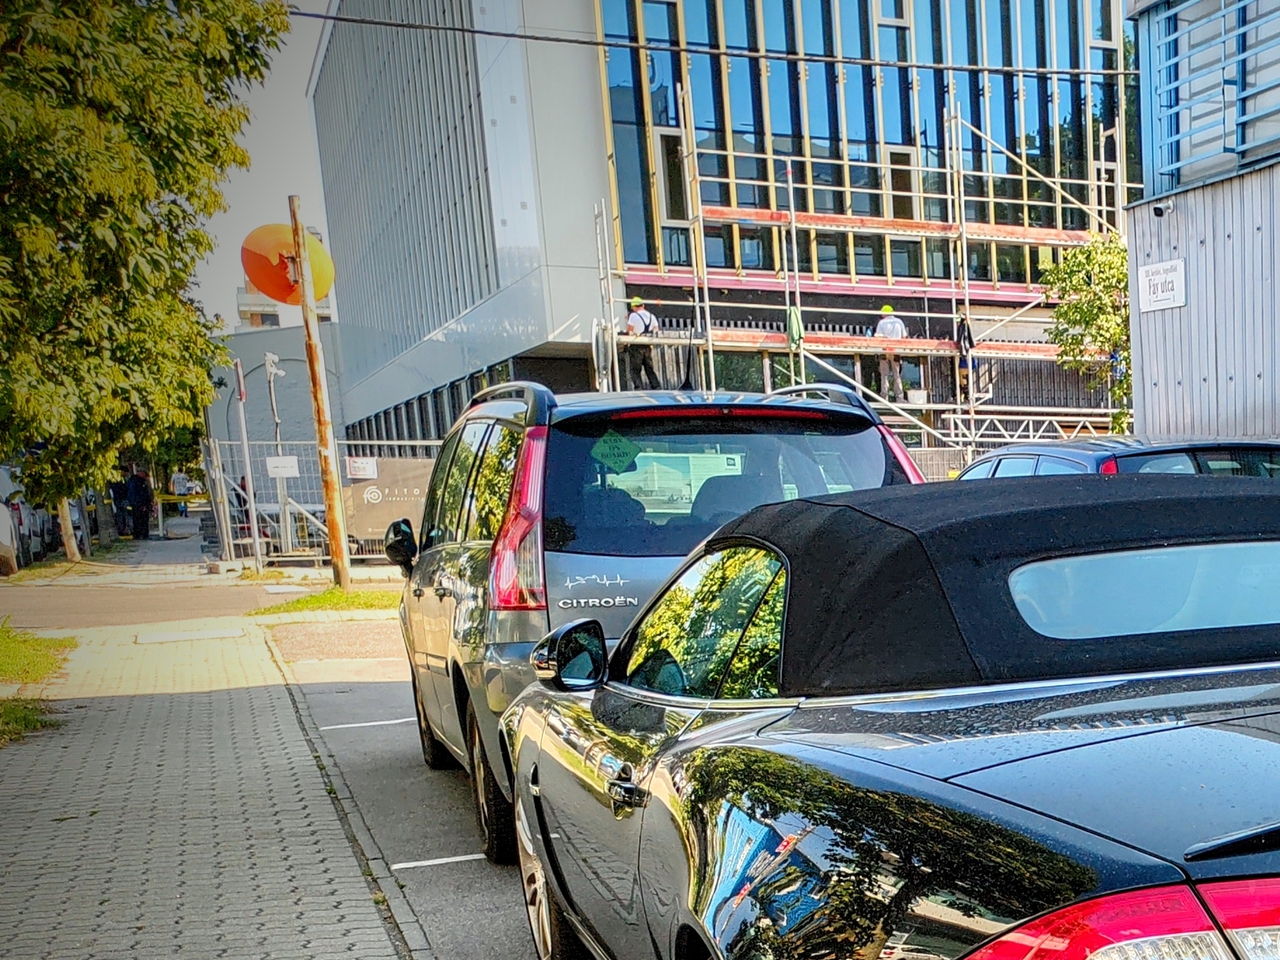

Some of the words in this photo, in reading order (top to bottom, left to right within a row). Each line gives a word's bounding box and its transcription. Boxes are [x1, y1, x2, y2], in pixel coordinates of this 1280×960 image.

[1148, 278, 1159, 298] Fáy
[1160, 277, 1175, 294] utca
[558, 596, 638, 609] CITROËN
